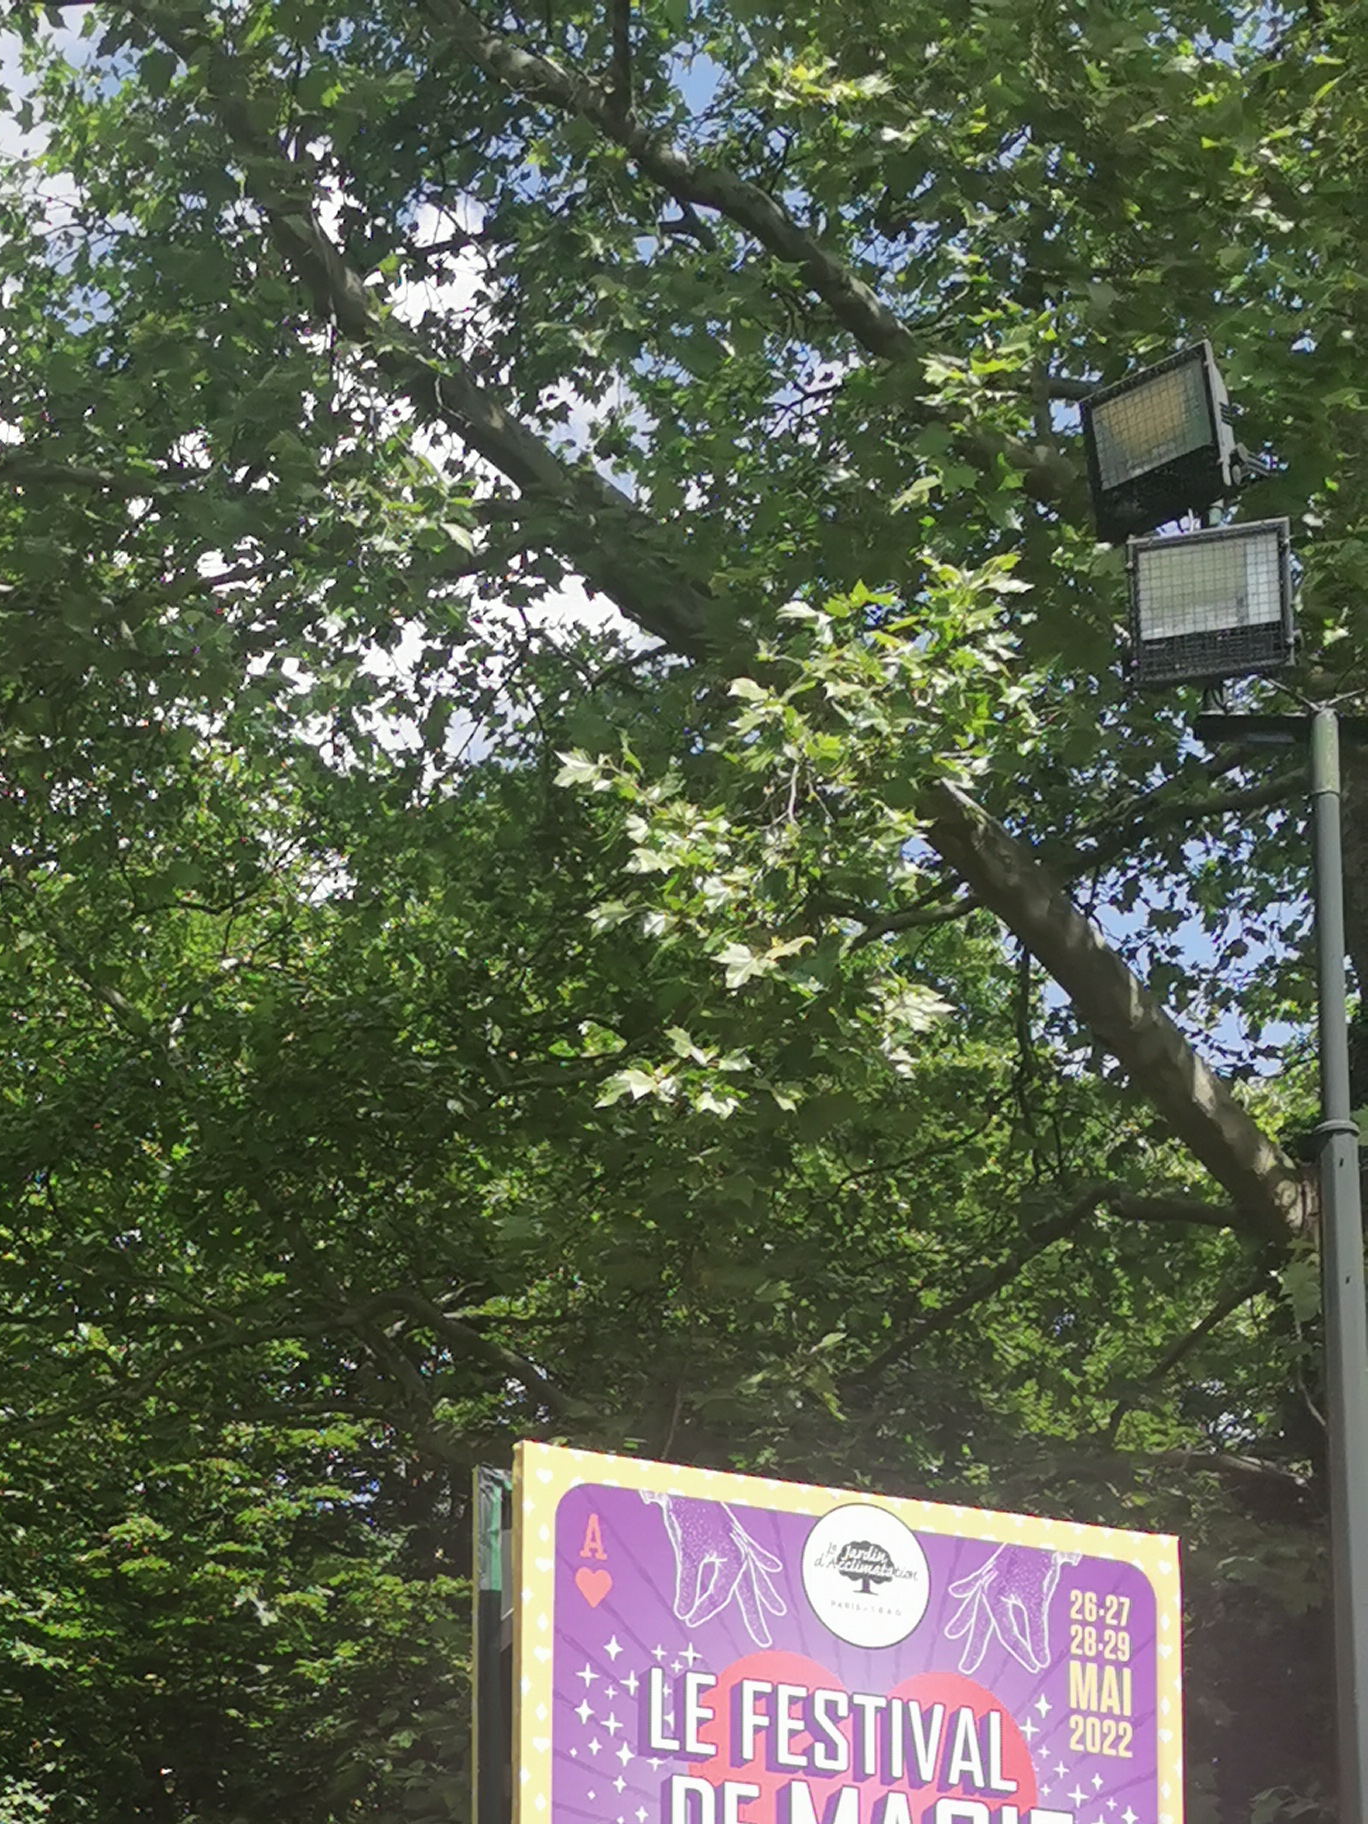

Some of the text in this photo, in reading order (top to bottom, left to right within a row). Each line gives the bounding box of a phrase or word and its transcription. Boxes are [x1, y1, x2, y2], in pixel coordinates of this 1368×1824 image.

[1069, 1660, 1131, 1717] MAI
[648, 1666, 1019, 1793] LE FESTIVAL
[1069, 1714, 1133, 1758] 2022
